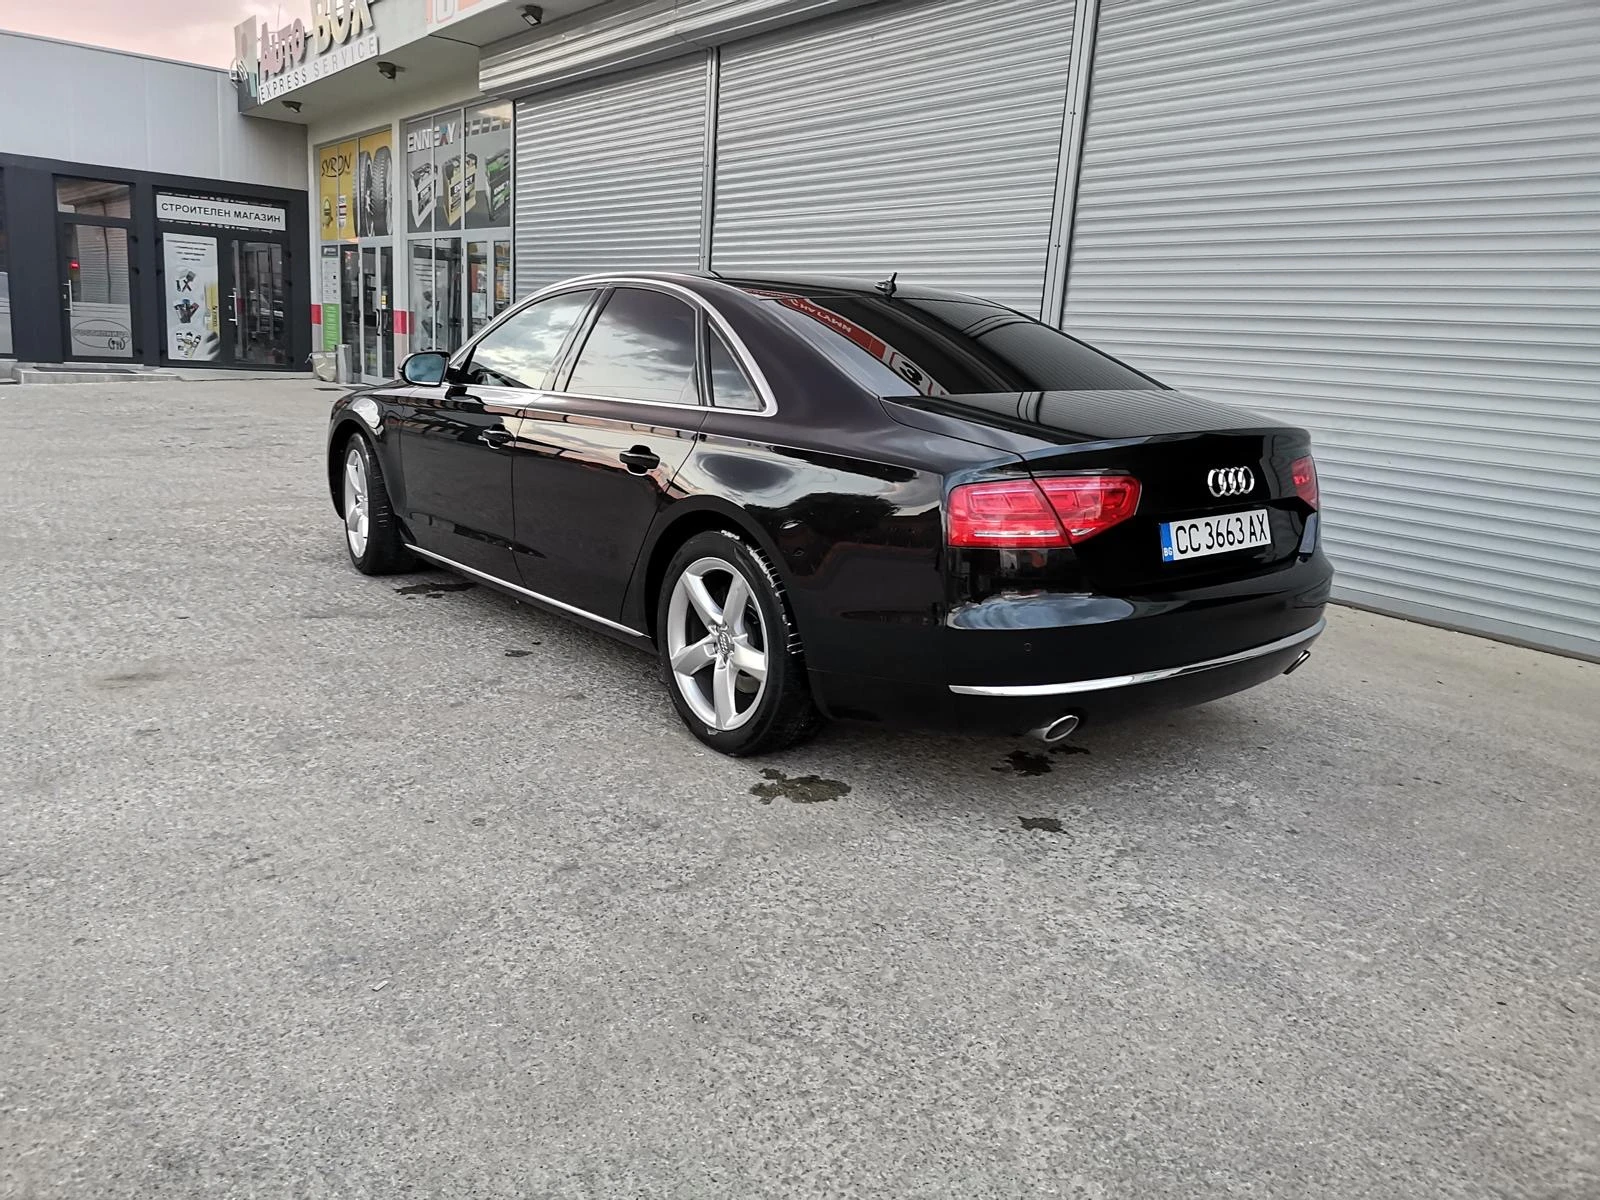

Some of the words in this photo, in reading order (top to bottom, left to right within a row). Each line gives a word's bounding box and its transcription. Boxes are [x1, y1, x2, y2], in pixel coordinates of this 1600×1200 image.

[260, 67, 307, 101] EXPRESS
[313, 36, 376, 78] SERVICE
[161, 202, 231, 218] СТРОИТЕЛЕН
[233, 210, 281, 223] МАГАЗИН
[1163, 546, 1173, 557] BG
[1175, 523, 1201, 555] CC
[1204, 517, 1245, 550] 3663
[1249, 513, 1268, 543] AX
